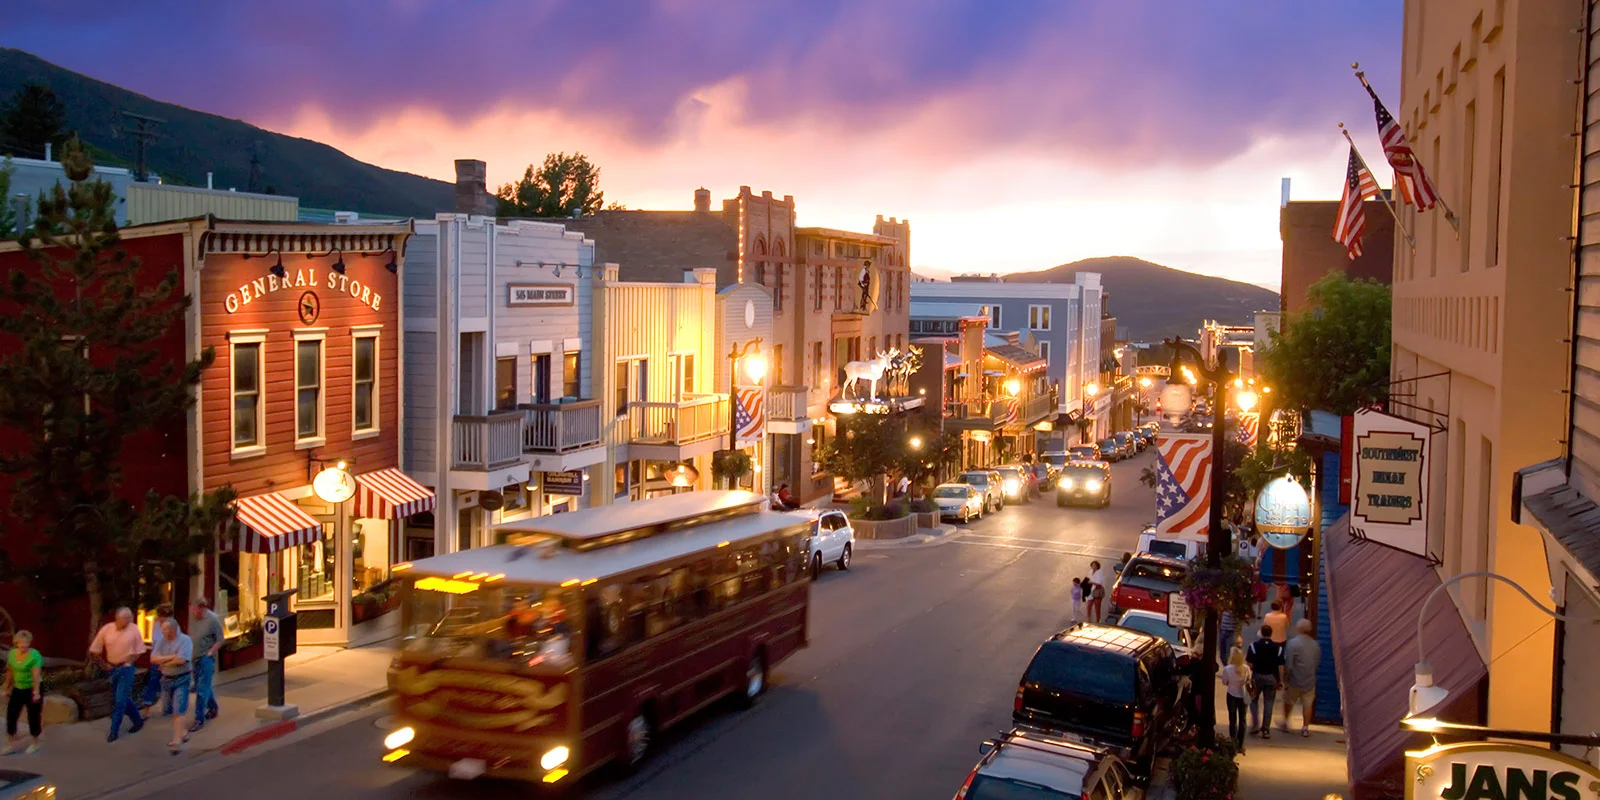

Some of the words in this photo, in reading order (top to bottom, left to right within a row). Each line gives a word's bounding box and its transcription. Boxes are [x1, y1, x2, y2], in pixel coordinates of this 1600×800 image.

[225, 268, 318, 314] GENERAL
[327, 271, 382, 312] STORE
[527, 290, 545, 300] MAIN
[545, 290, 567, 300] STREET
[1361, 446, 1419, 462] SOUTHWEST
[1372, 470, 1406, 485] INDIAN
[1366, 493, 1412, 510] TRADERS
[268, 621, 276, 633] P
[1440, 762, 1581, 800] JANS
